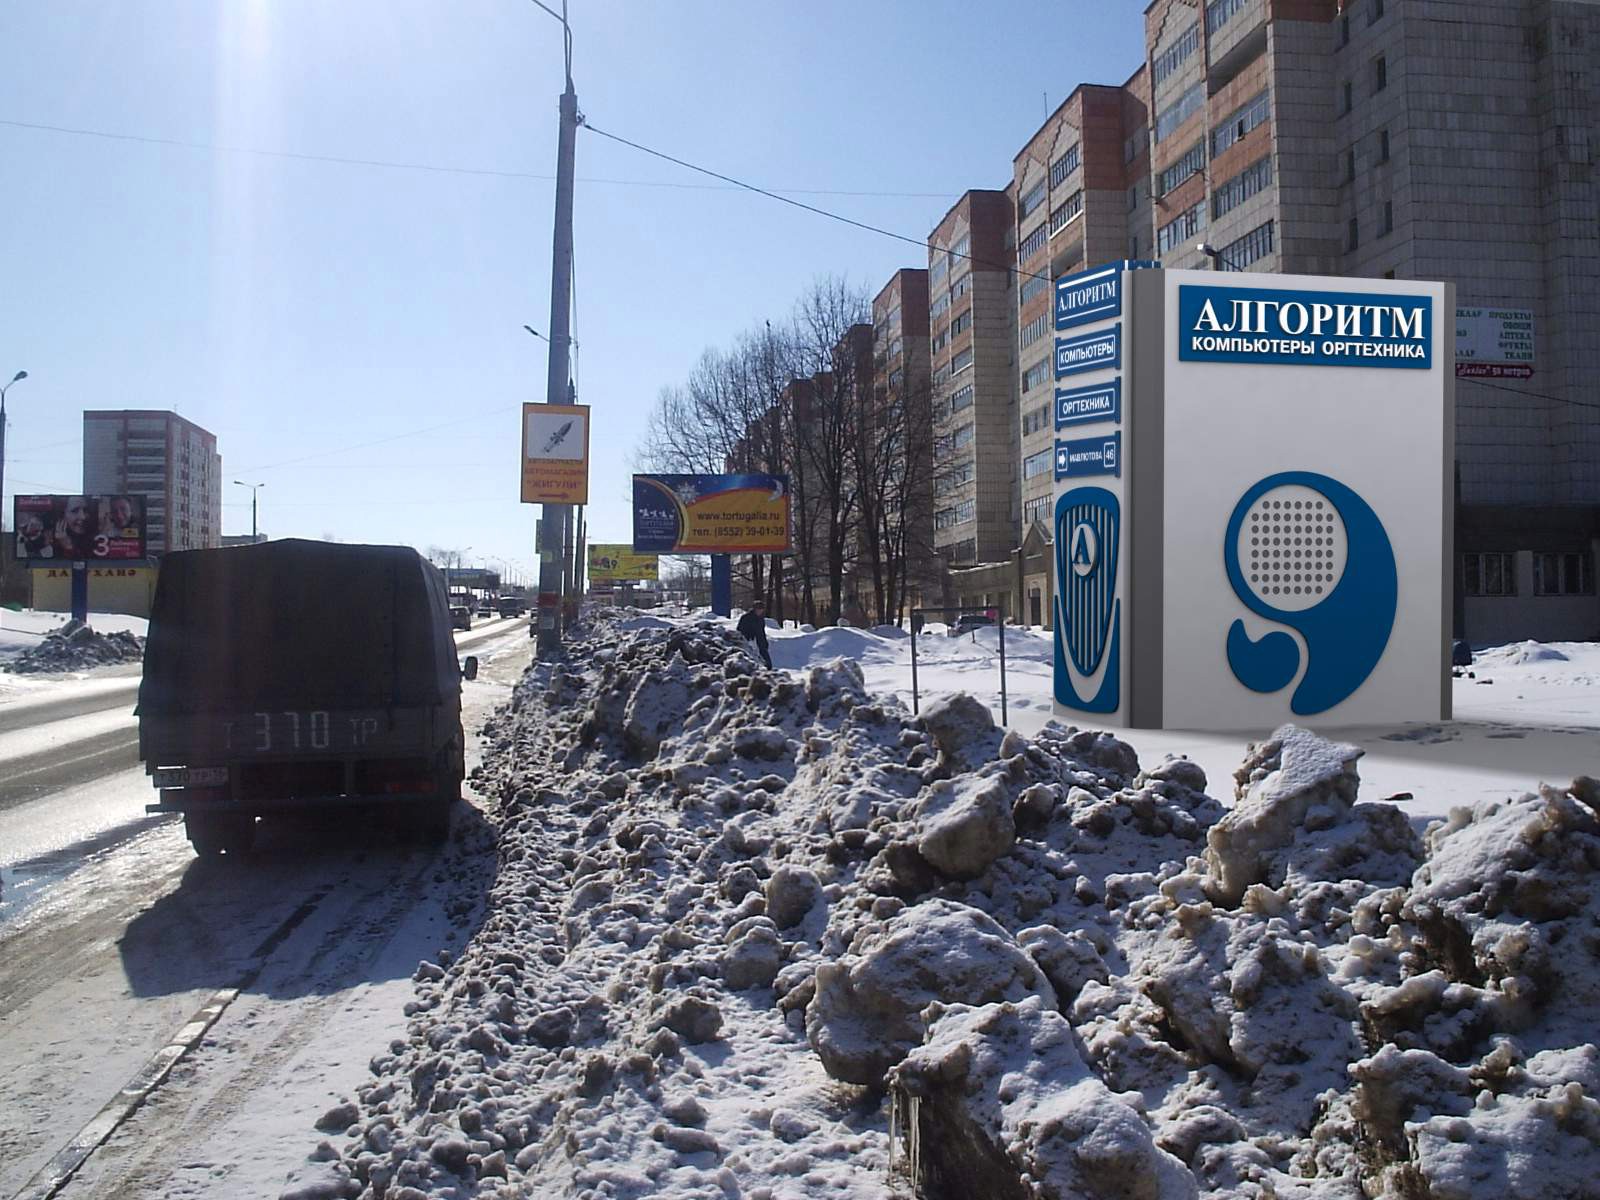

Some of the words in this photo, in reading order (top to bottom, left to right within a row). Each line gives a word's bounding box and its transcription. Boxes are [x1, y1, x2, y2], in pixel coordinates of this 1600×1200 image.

[1058, 280, 1116, 312] АЛГОРИТМ
[1192, 298, 1426, 339] АЛГОРИТМ
[1488, 311, 1532, 320] ПРОДУКТЫ
[1502, 321, 1532, 330] ОВОЩИ
[1499, 331, 1532, 340] АПТЕКА
[1192, 336, 1315, 355] КОМПЬЮТЕРЫ
[1321, 340, 1426, 359] ОРГТЕХНИКА
[1498, 341, 1533, 350] ФРУКТЫ
[1060, 341, 1114, 364] КОМПЬЮТЕРЫ
[1504, 351, 1533, 360] ТКАНИ
[1062, 395, 1110, 415] ОРГТЕХНИКА
[1105, 449, 1114, 461] 46
[697, 512, 780, 522] www.tortugalia.ru
[714, 526, 744, 538] (8552)
[93, 534, 110, 556] 3
[254, 711, 330, 751] 370
